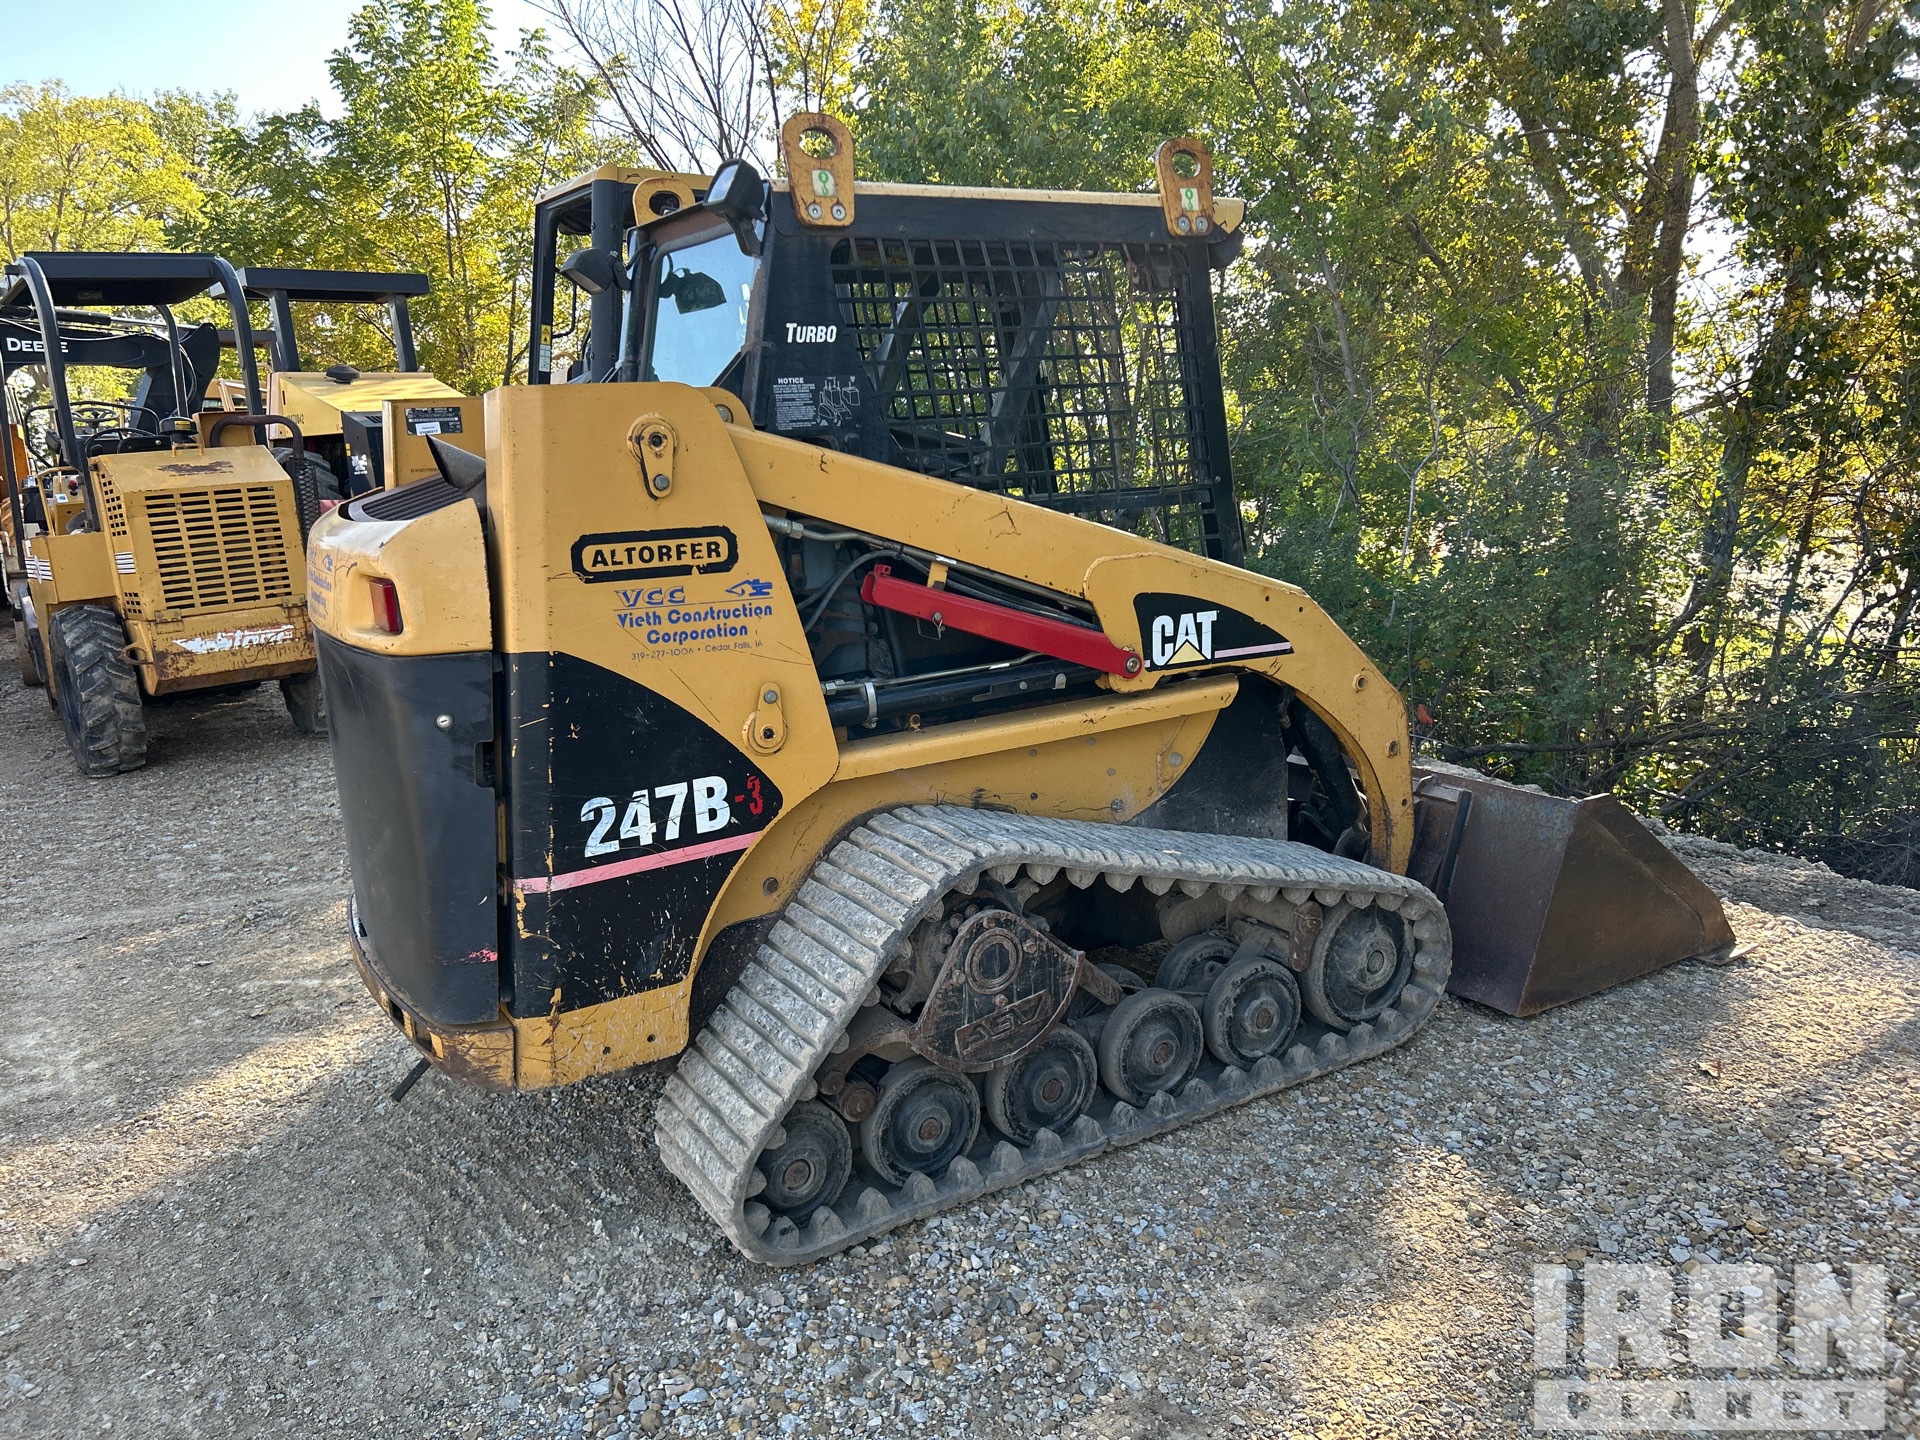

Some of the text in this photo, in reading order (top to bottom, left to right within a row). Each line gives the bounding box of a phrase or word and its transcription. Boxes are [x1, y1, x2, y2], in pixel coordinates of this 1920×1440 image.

[6, 337, 69, 352] DEEE
[777, 377, 804, 385] NOTICE
[591, 541, 722, 568] ALTORFER
[613, 586, 686, 608] VCC
[617, 602, 773, 629] Vieth Construction
[646, 622, 749, 646] Corporation
[1152, 610, 1218, 666] CAT
[704, 643, 731, 653] Cedar
[755, 640, 763, 648] IA
